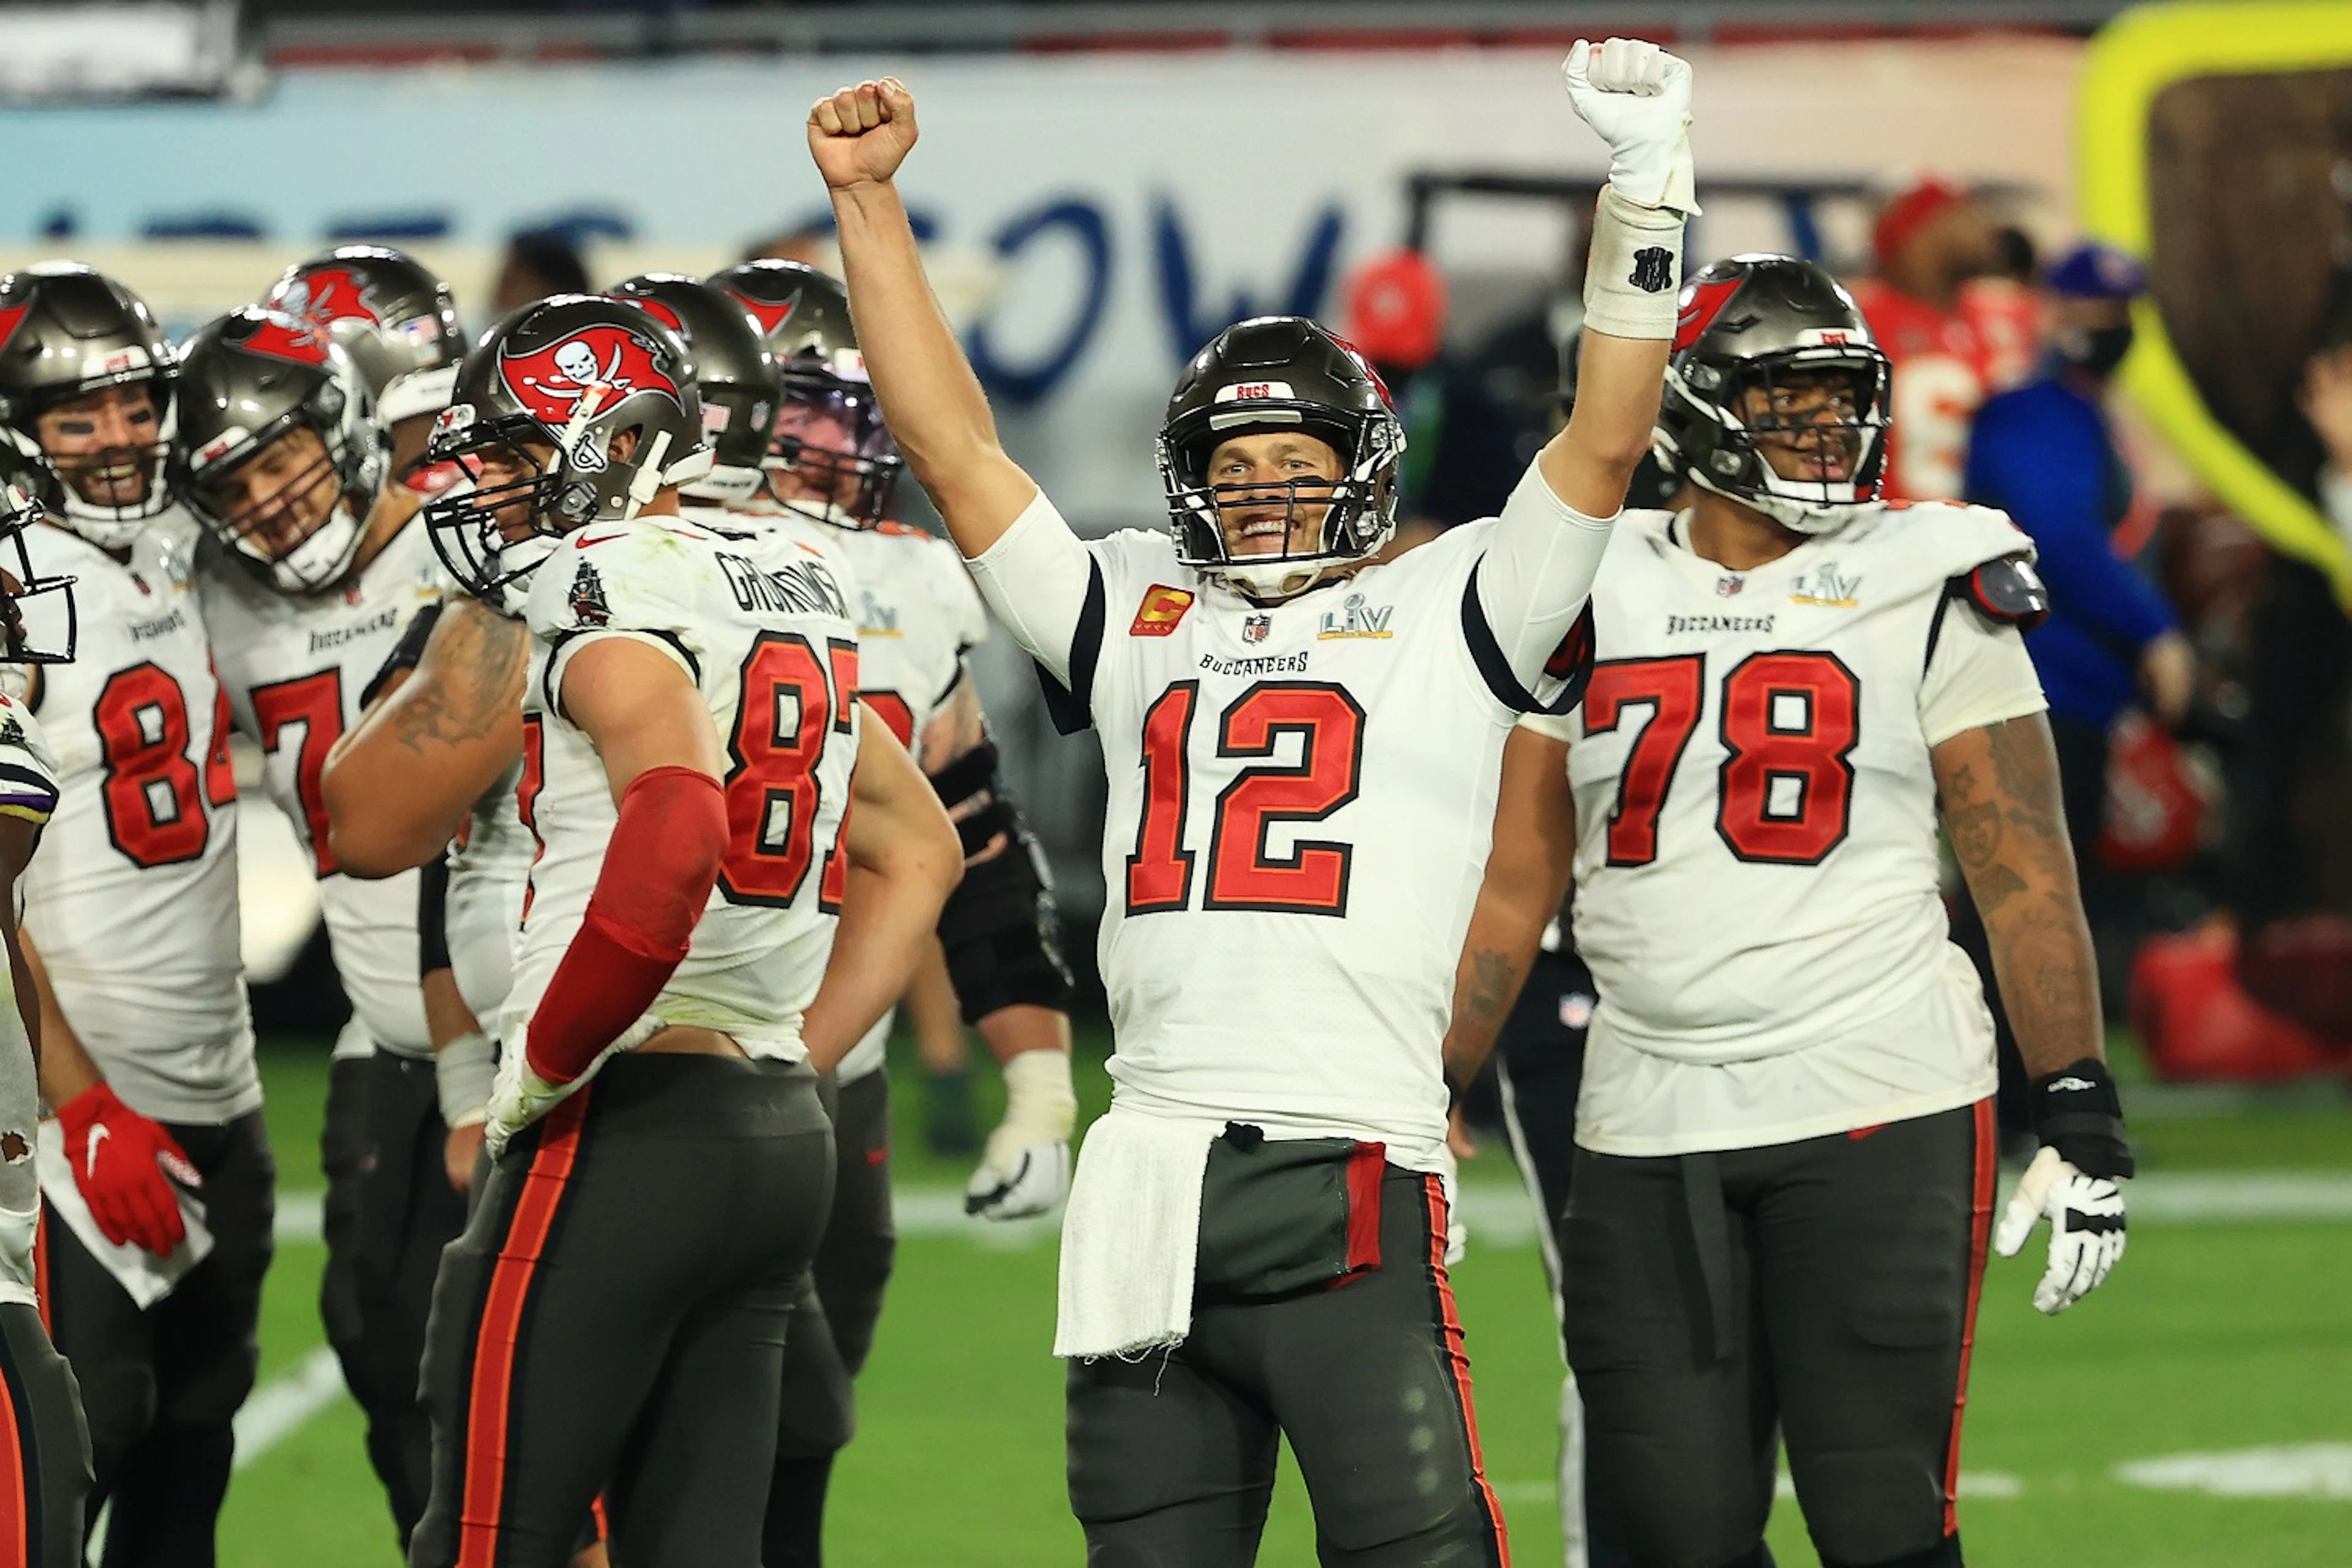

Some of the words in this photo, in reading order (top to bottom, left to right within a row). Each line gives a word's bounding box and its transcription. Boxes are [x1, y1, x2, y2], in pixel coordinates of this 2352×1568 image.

[1140, 589, 1191, 622] C
[1199, 651, 1309, 677] BUCCANEERS
[1125, 679, 1367, 919] 12
[1583, 649, 1860, 867] 78
